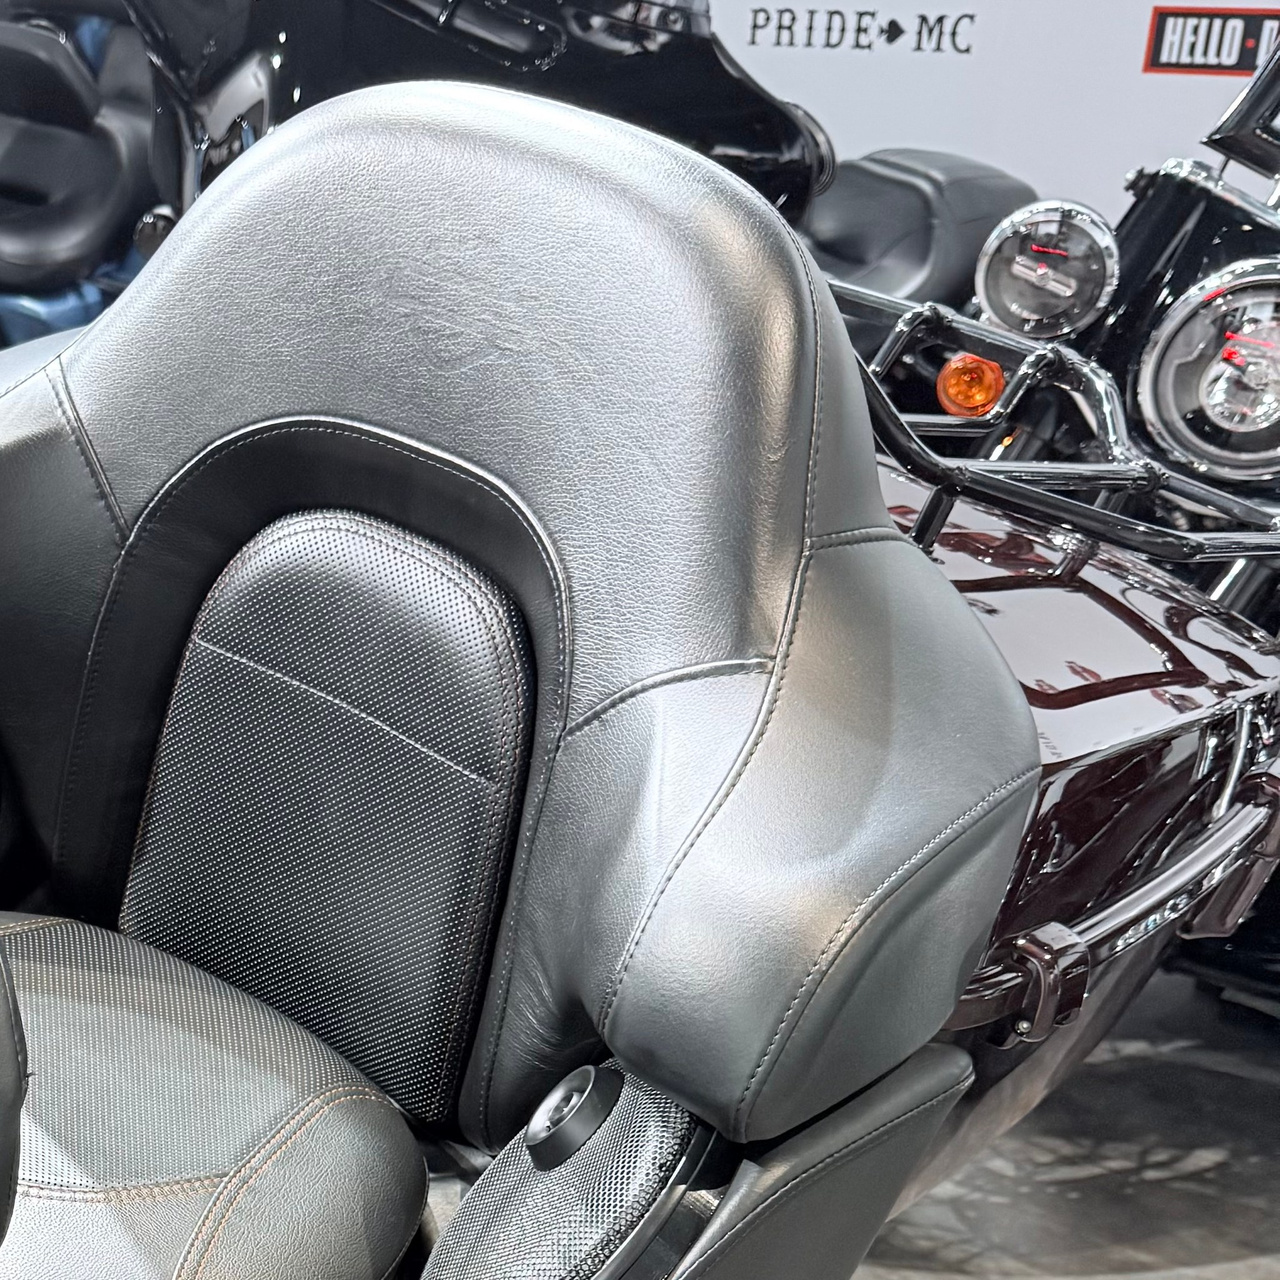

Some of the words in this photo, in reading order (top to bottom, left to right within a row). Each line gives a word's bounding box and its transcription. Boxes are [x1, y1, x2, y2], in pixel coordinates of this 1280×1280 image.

[747, 8, 878, 50] PRIDE
[912, 13, 977, 54] MC
[1159, 16, 1245, 66] HELLO
